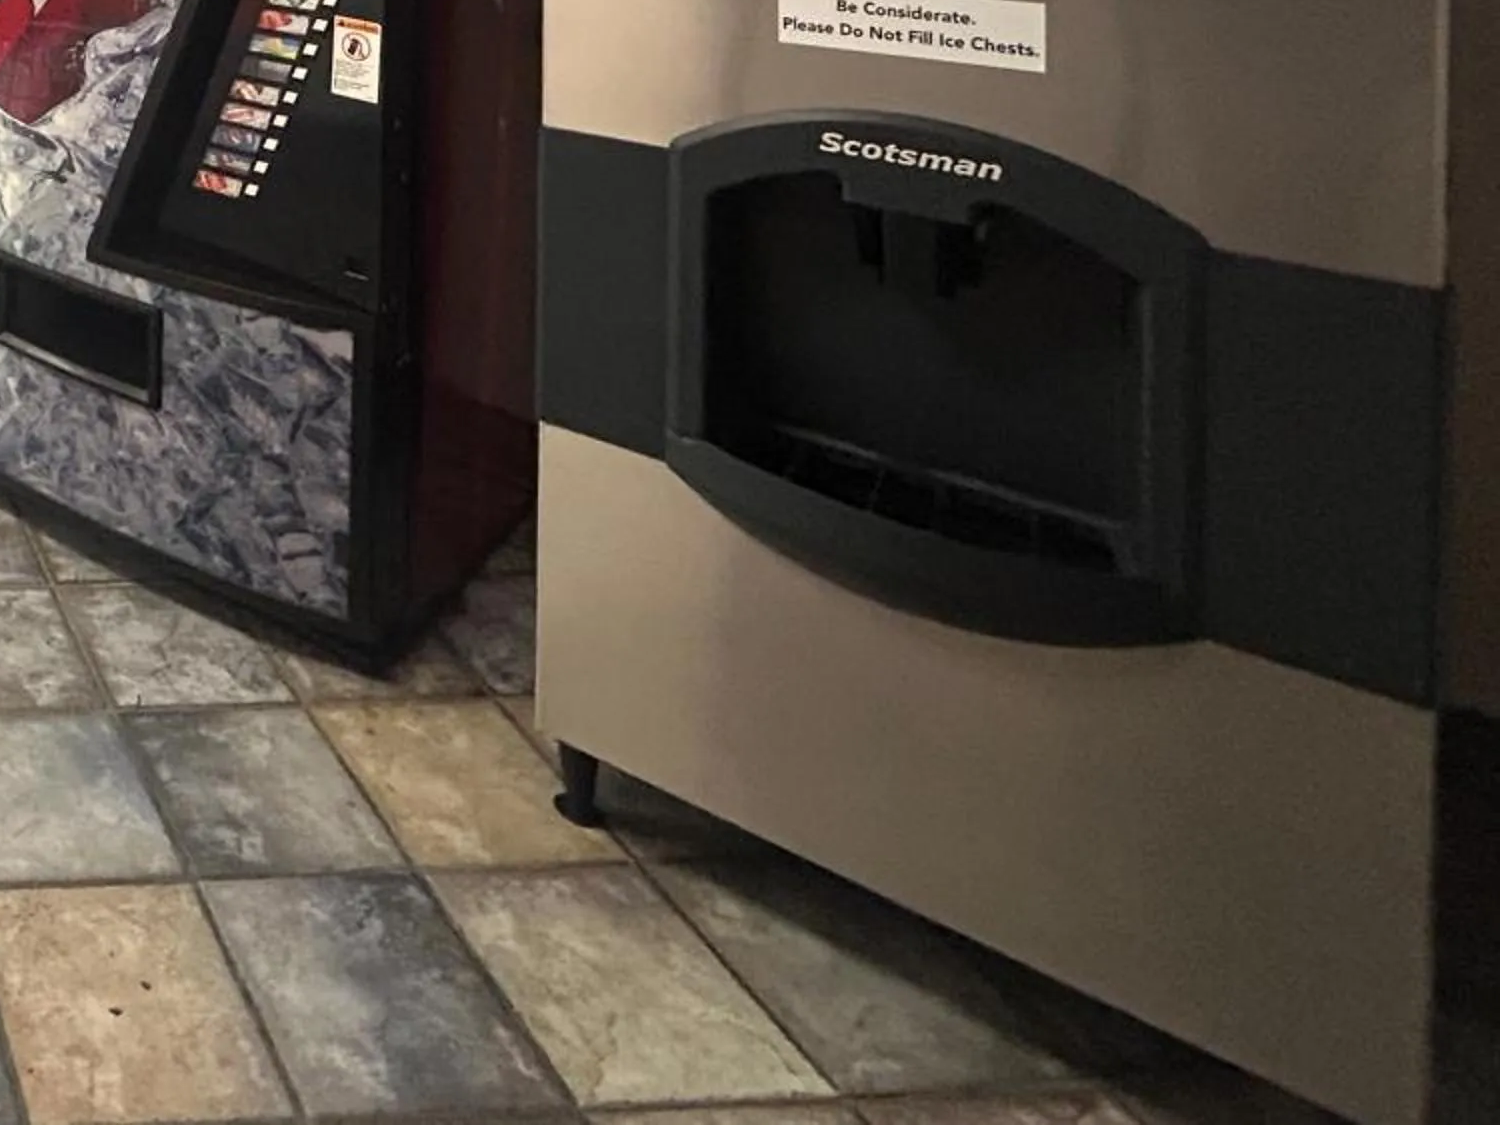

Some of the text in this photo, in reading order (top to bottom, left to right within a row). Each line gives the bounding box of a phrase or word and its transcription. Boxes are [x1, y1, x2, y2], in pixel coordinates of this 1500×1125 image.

[836, 0, 977, 26] Be Considerate.
[782, 16, 1041, 58] Please Do Not Fill Ice Chests.
[818, 131, 1004, 183] Scotsman
